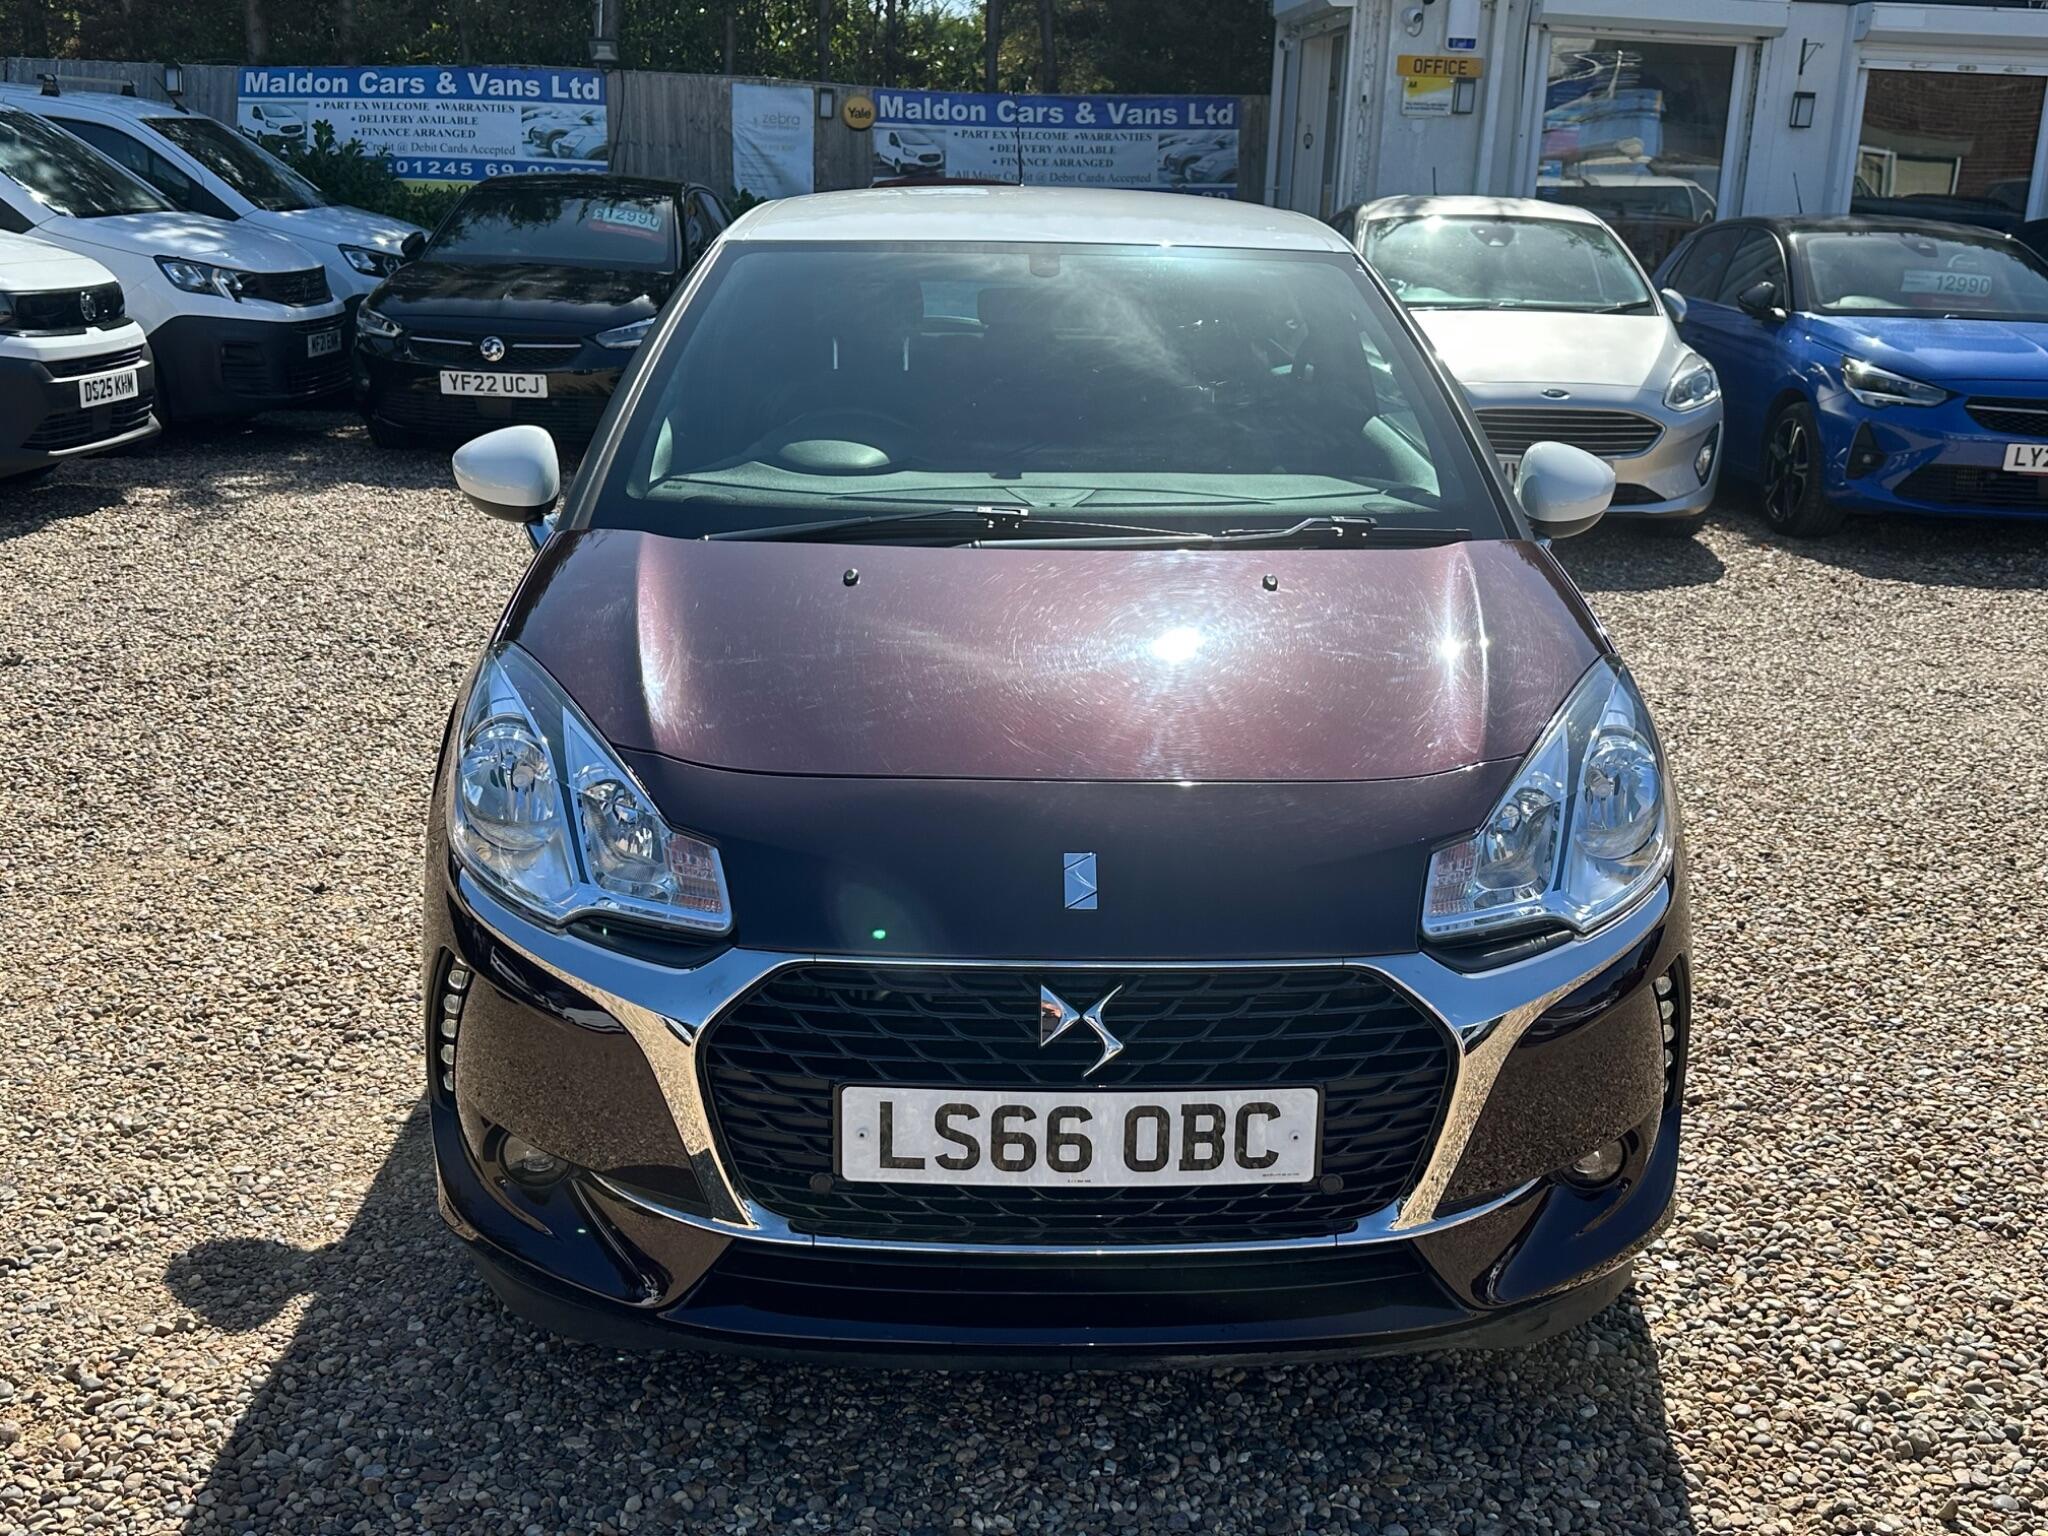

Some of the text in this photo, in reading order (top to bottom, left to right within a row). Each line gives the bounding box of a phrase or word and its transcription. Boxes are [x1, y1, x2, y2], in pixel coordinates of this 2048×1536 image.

[1413, 58, 1468, 76] OFFICE
[245, 71, 600, 100] Maldon Cars & Vans Ltd
[323, 101, 515, 113] PART EX WELCOME WARRANTIES
[848, 107, 872, 120] Yale
[880, 95, 1234, 126] Maldon Cars & Vans Ltd
[359, 114, 479, 126] DELIVERY AVAILABLE
[762, 112, 801, 126] zebra
[362, 127, 476, 139] FINANCE ARRANGED
[961, 129, 1153, 142] PART EX WELCOME WARRANTIES
[365, 141, 394, 152] Credit
[411, 142, 437, 153] Debit
[440, 142, 469, 154] Cards
[470, 144, 516, 158] Accepted
[997, 143, 1118, 155] DELIVERY AVAILABLE
[1000, 157, 1114, 169] FINANCE ARRANGED
[1049, 172, 1075, 183] Debit
[1078, 172, 1105, 183] Cards
[1108, 172, 1152, 185] Accepted
[1935, 274, 1991, 295] 12990
[84, 372, 134, 402] DS25 KHM
[448, 373, 540, 394] YF22 UCJ
[879, 1100, 1281, 1173] LS66 OBC
